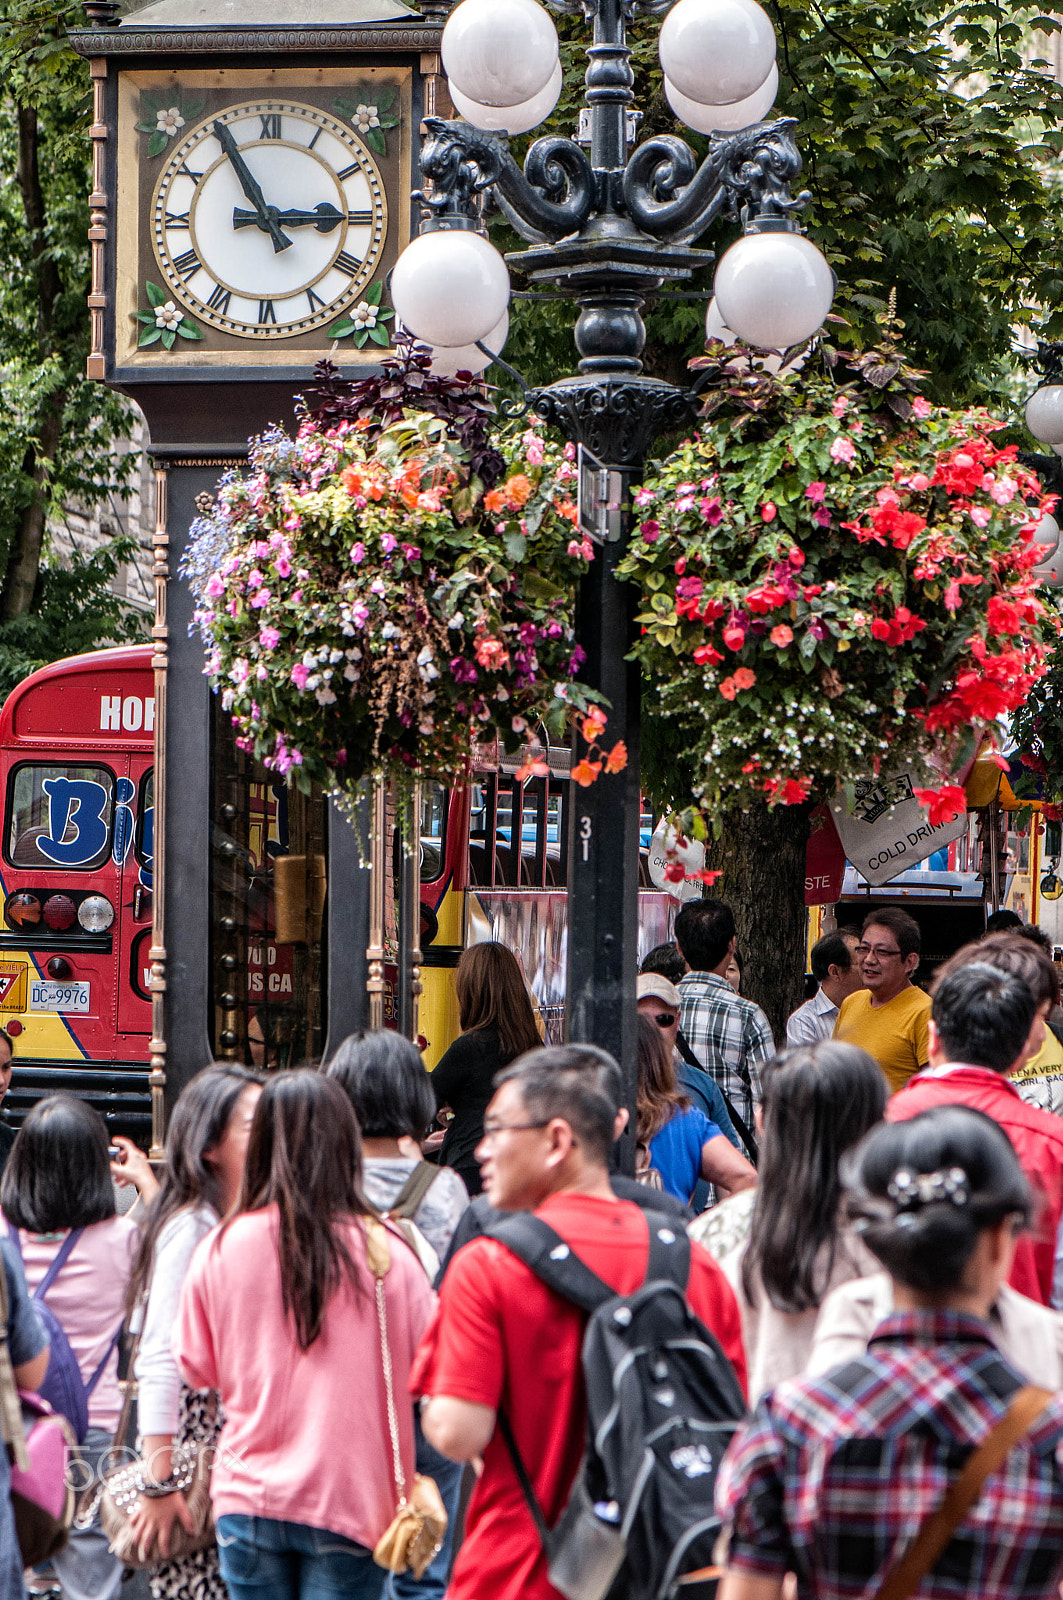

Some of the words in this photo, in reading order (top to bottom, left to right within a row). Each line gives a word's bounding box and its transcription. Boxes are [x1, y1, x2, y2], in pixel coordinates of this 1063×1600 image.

[260, 114, 281, 139] XII
[308, 127, 322, 149] I
[177, 162, 204, 185] X
[337, 162, 361, 181] II
[348, 211, 372, 226] III
[173, 249, 201, 283] VIII
[206, 285, 232, 316] VII
[307, 288, 327, 313] V
[868, 840, 907, 870] COLD
[906, 813, 959, 846] DRIN
[56, 989, 88, 1004] 9976
[1008, 1070, 1030, 1078] EEN
[1032, 1068, 1038, 1076] A
[1039, 1064, 1062, 1074] VERY
